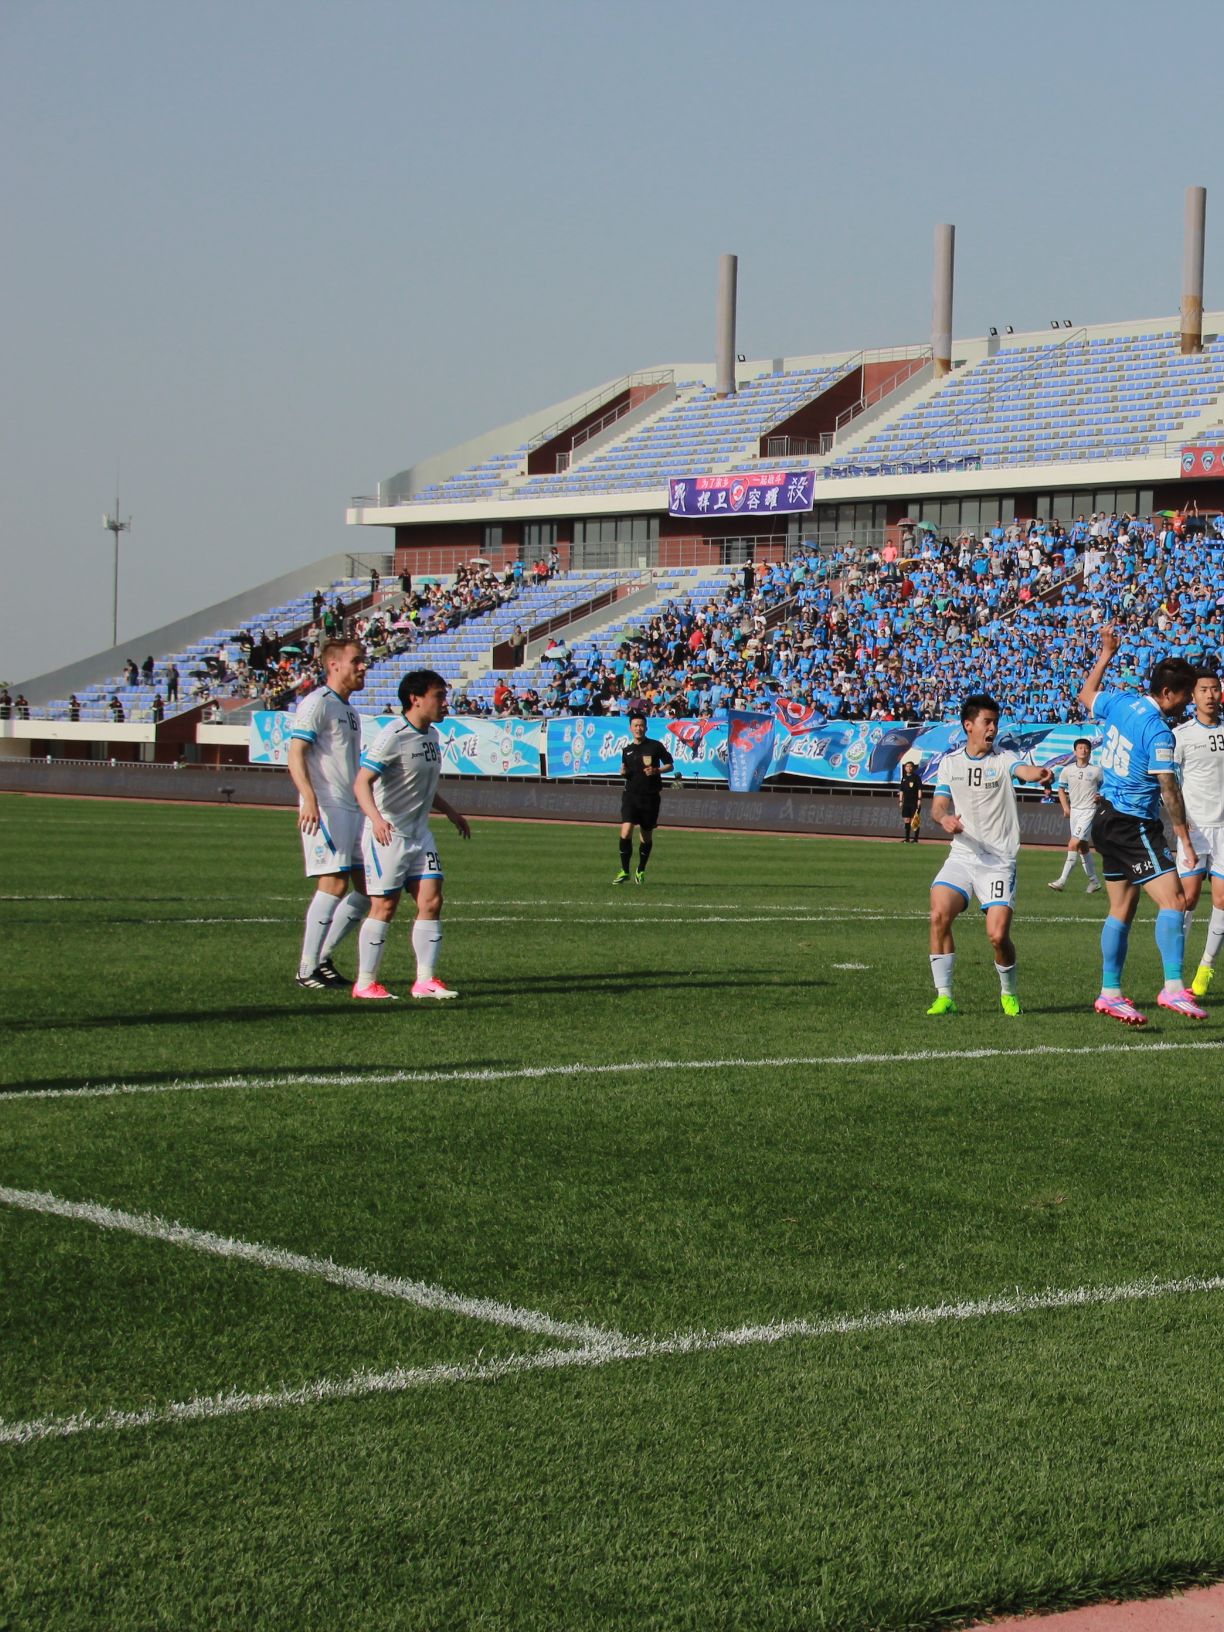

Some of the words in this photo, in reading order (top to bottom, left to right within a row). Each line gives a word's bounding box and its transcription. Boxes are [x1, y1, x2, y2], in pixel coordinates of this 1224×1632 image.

[422, 741, 437, 762] 28
[1100, 724, 1134, 777] 35
[967, 767, 983, 787] 19
[990, 880, 1004, 900] 19
